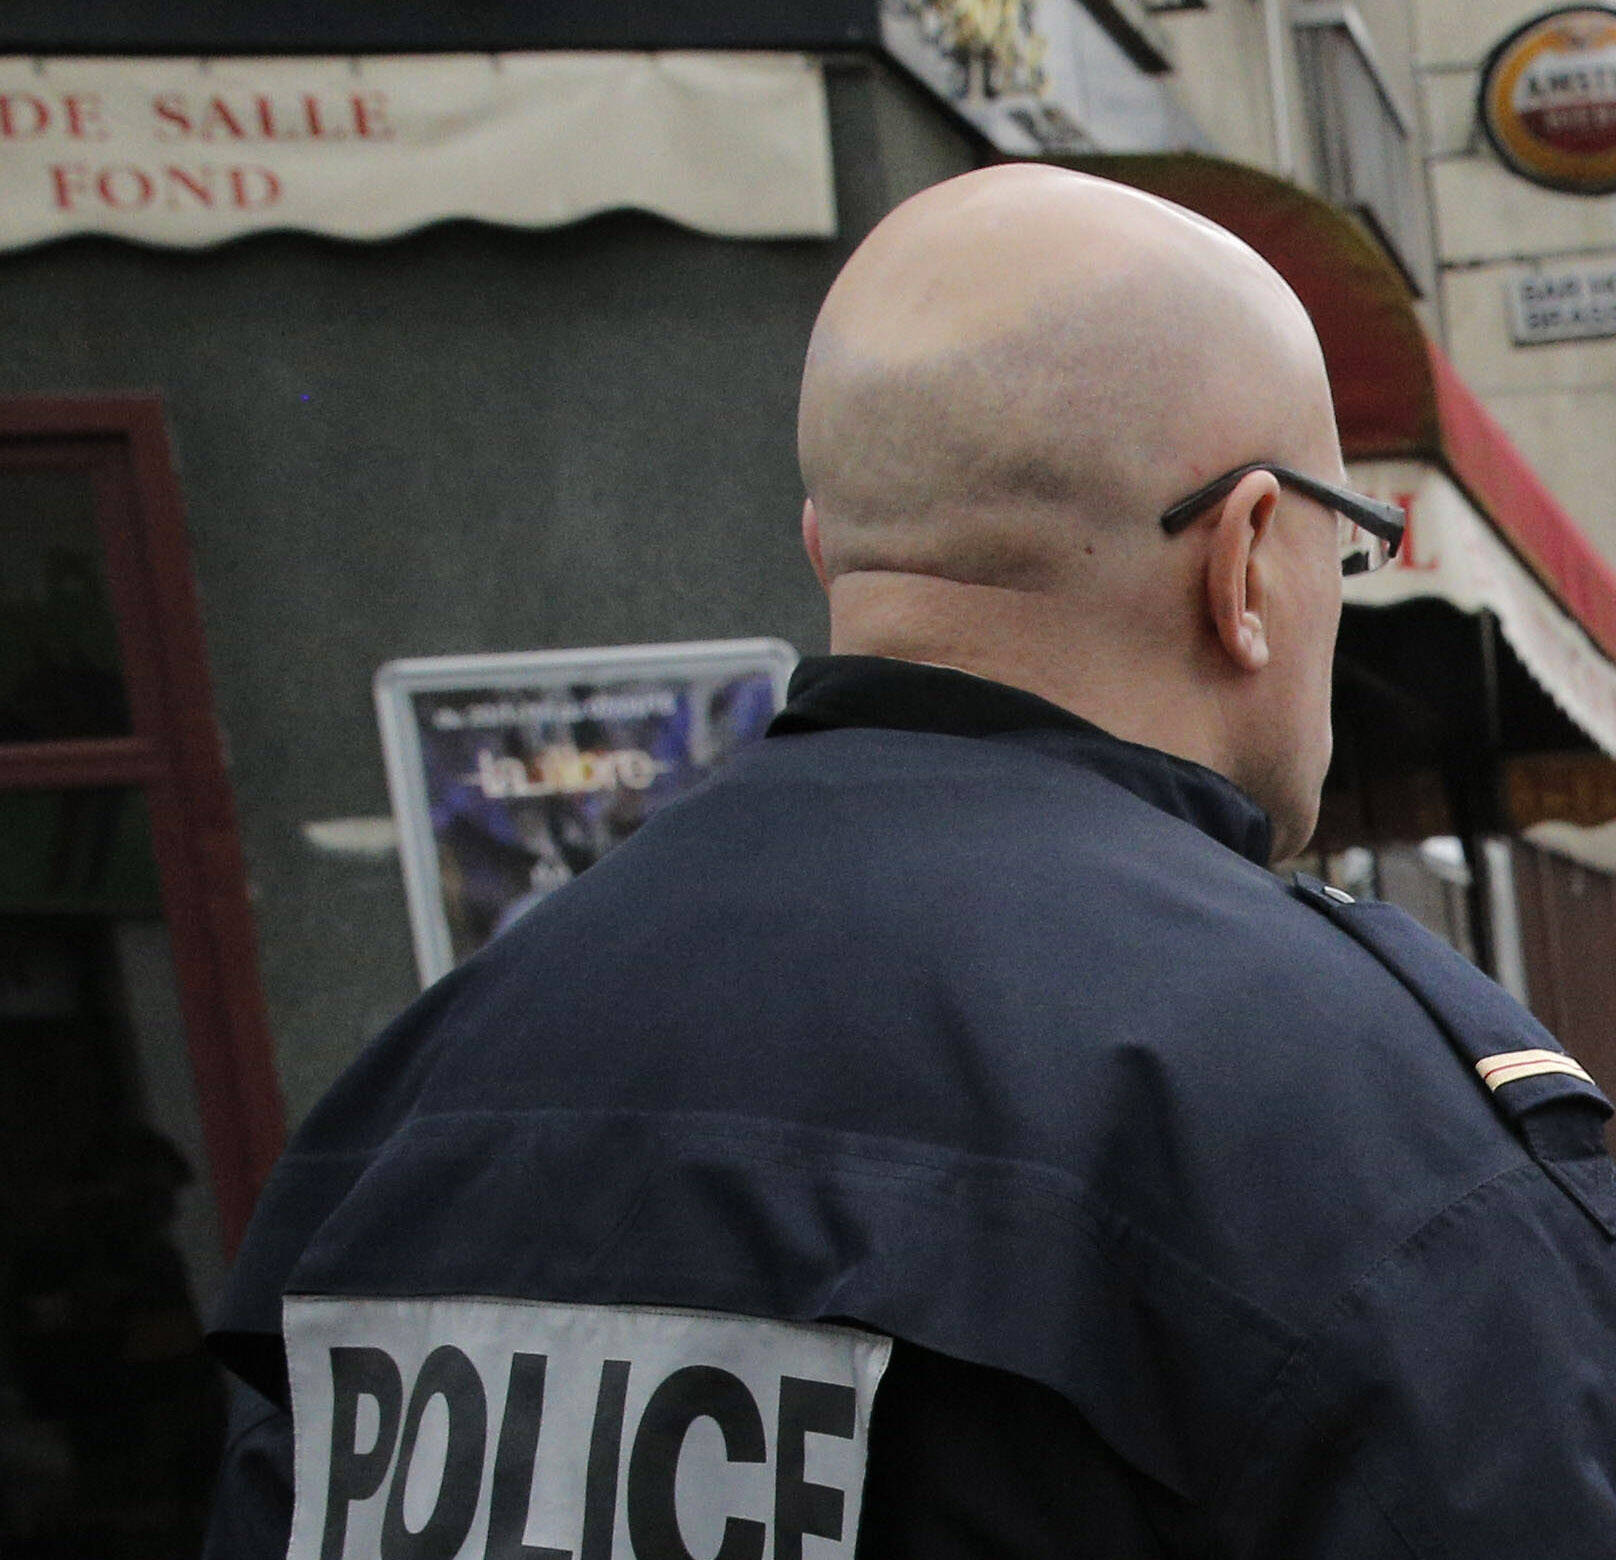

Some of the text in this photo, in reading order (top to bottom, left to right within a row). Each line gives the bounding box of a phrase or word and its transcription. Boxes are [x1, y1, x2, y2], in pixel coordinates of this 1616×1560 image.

[0, 92, 396, 142] DE SALLE
[50, 163, 281, 212] FOND
